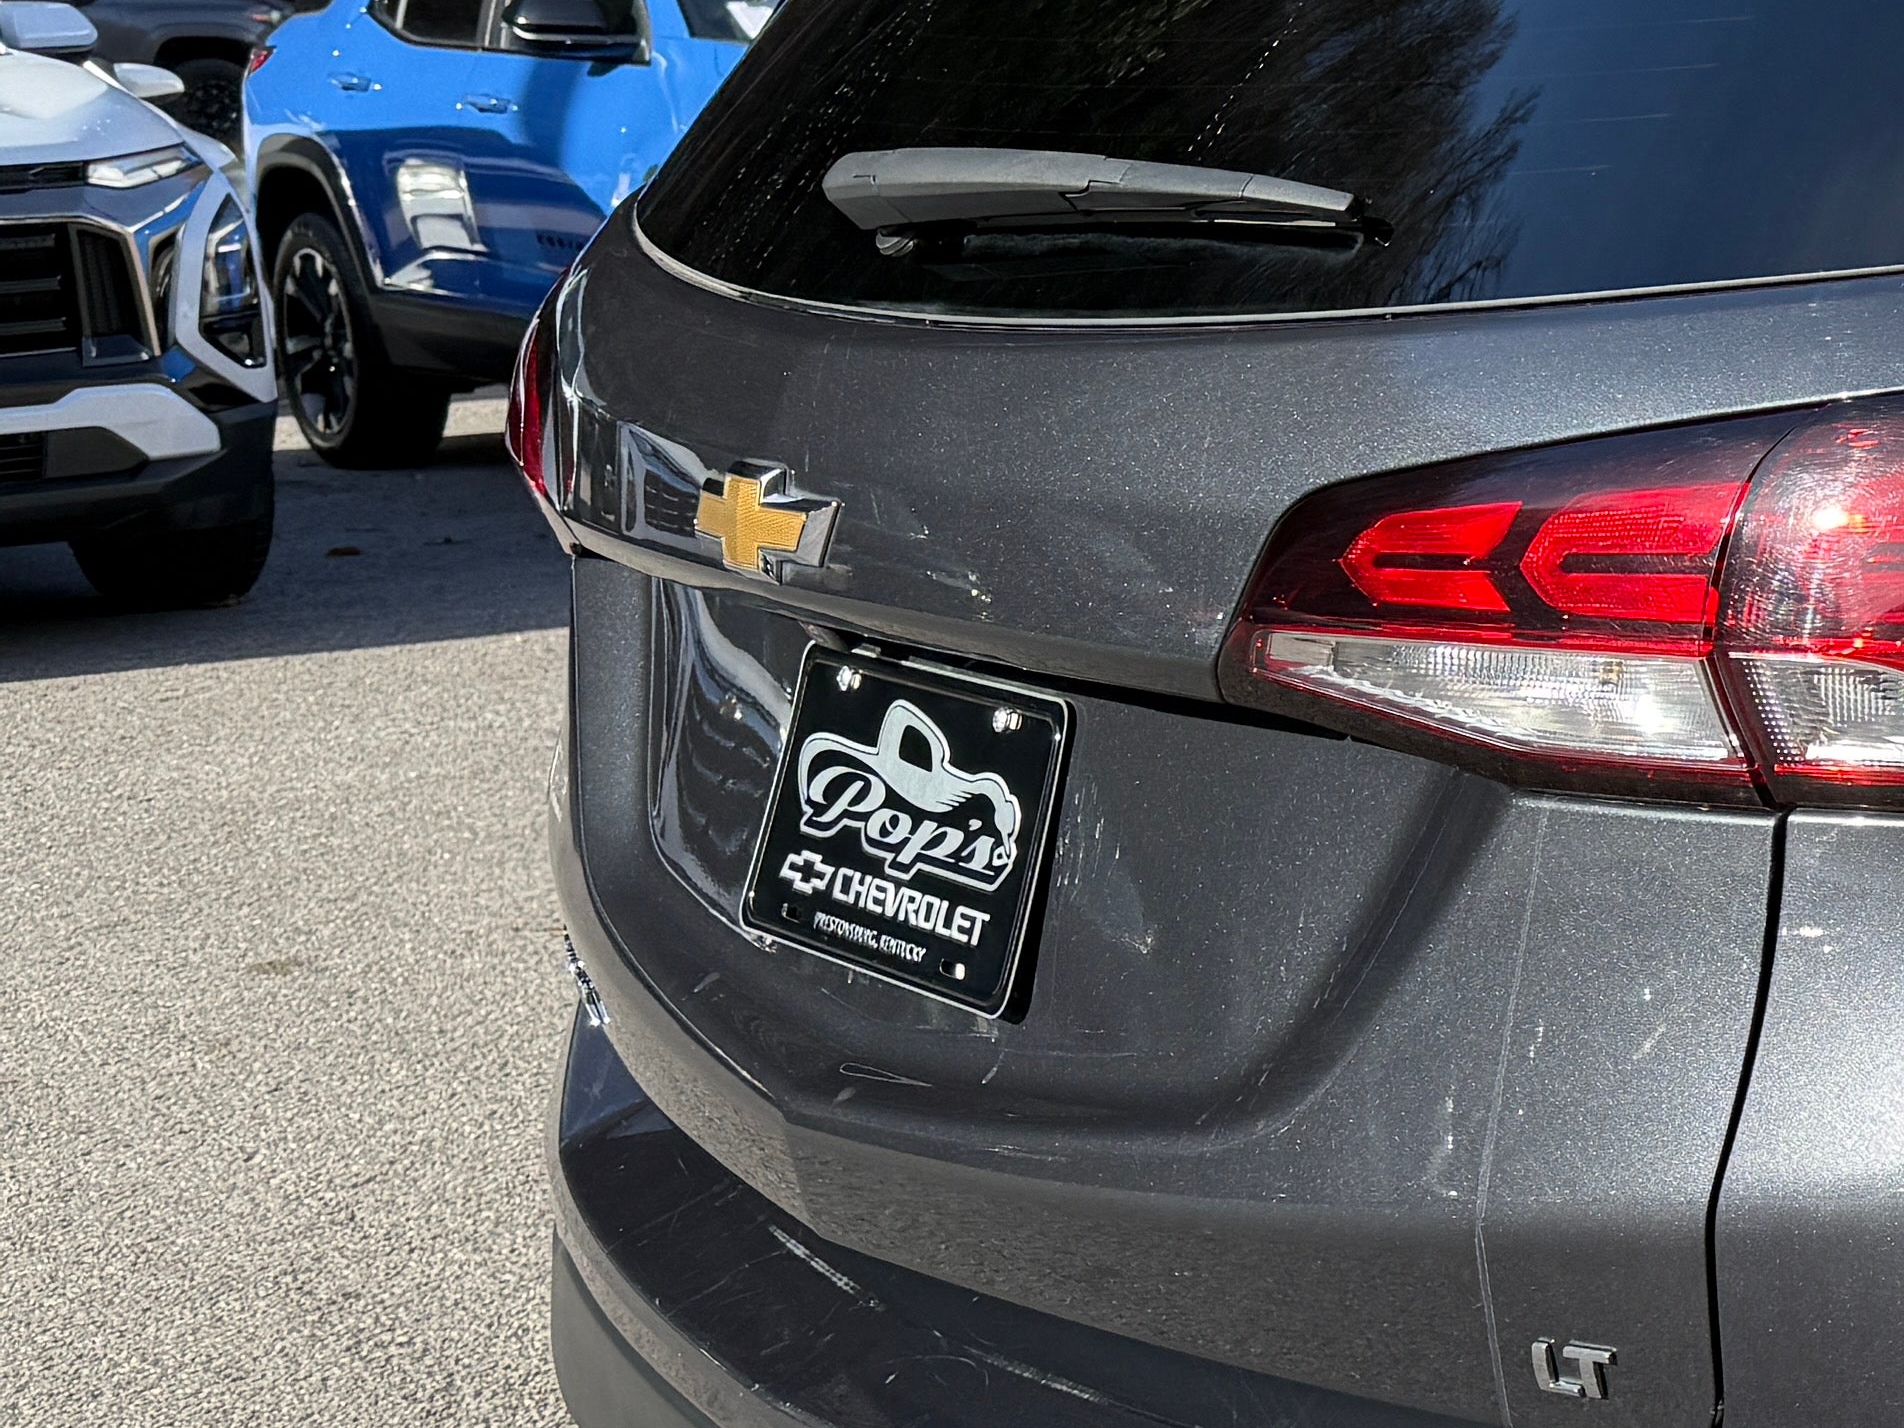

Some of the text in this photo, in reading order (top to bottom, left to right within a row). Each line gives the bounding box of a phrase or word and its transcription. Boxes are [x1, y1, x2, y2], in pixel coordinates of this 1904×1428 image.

[808, 765, 996, 869] Pop's
[831, 867, 991, 947] CHEVROLET
[1531, 1336, 1619, 1400] LT
